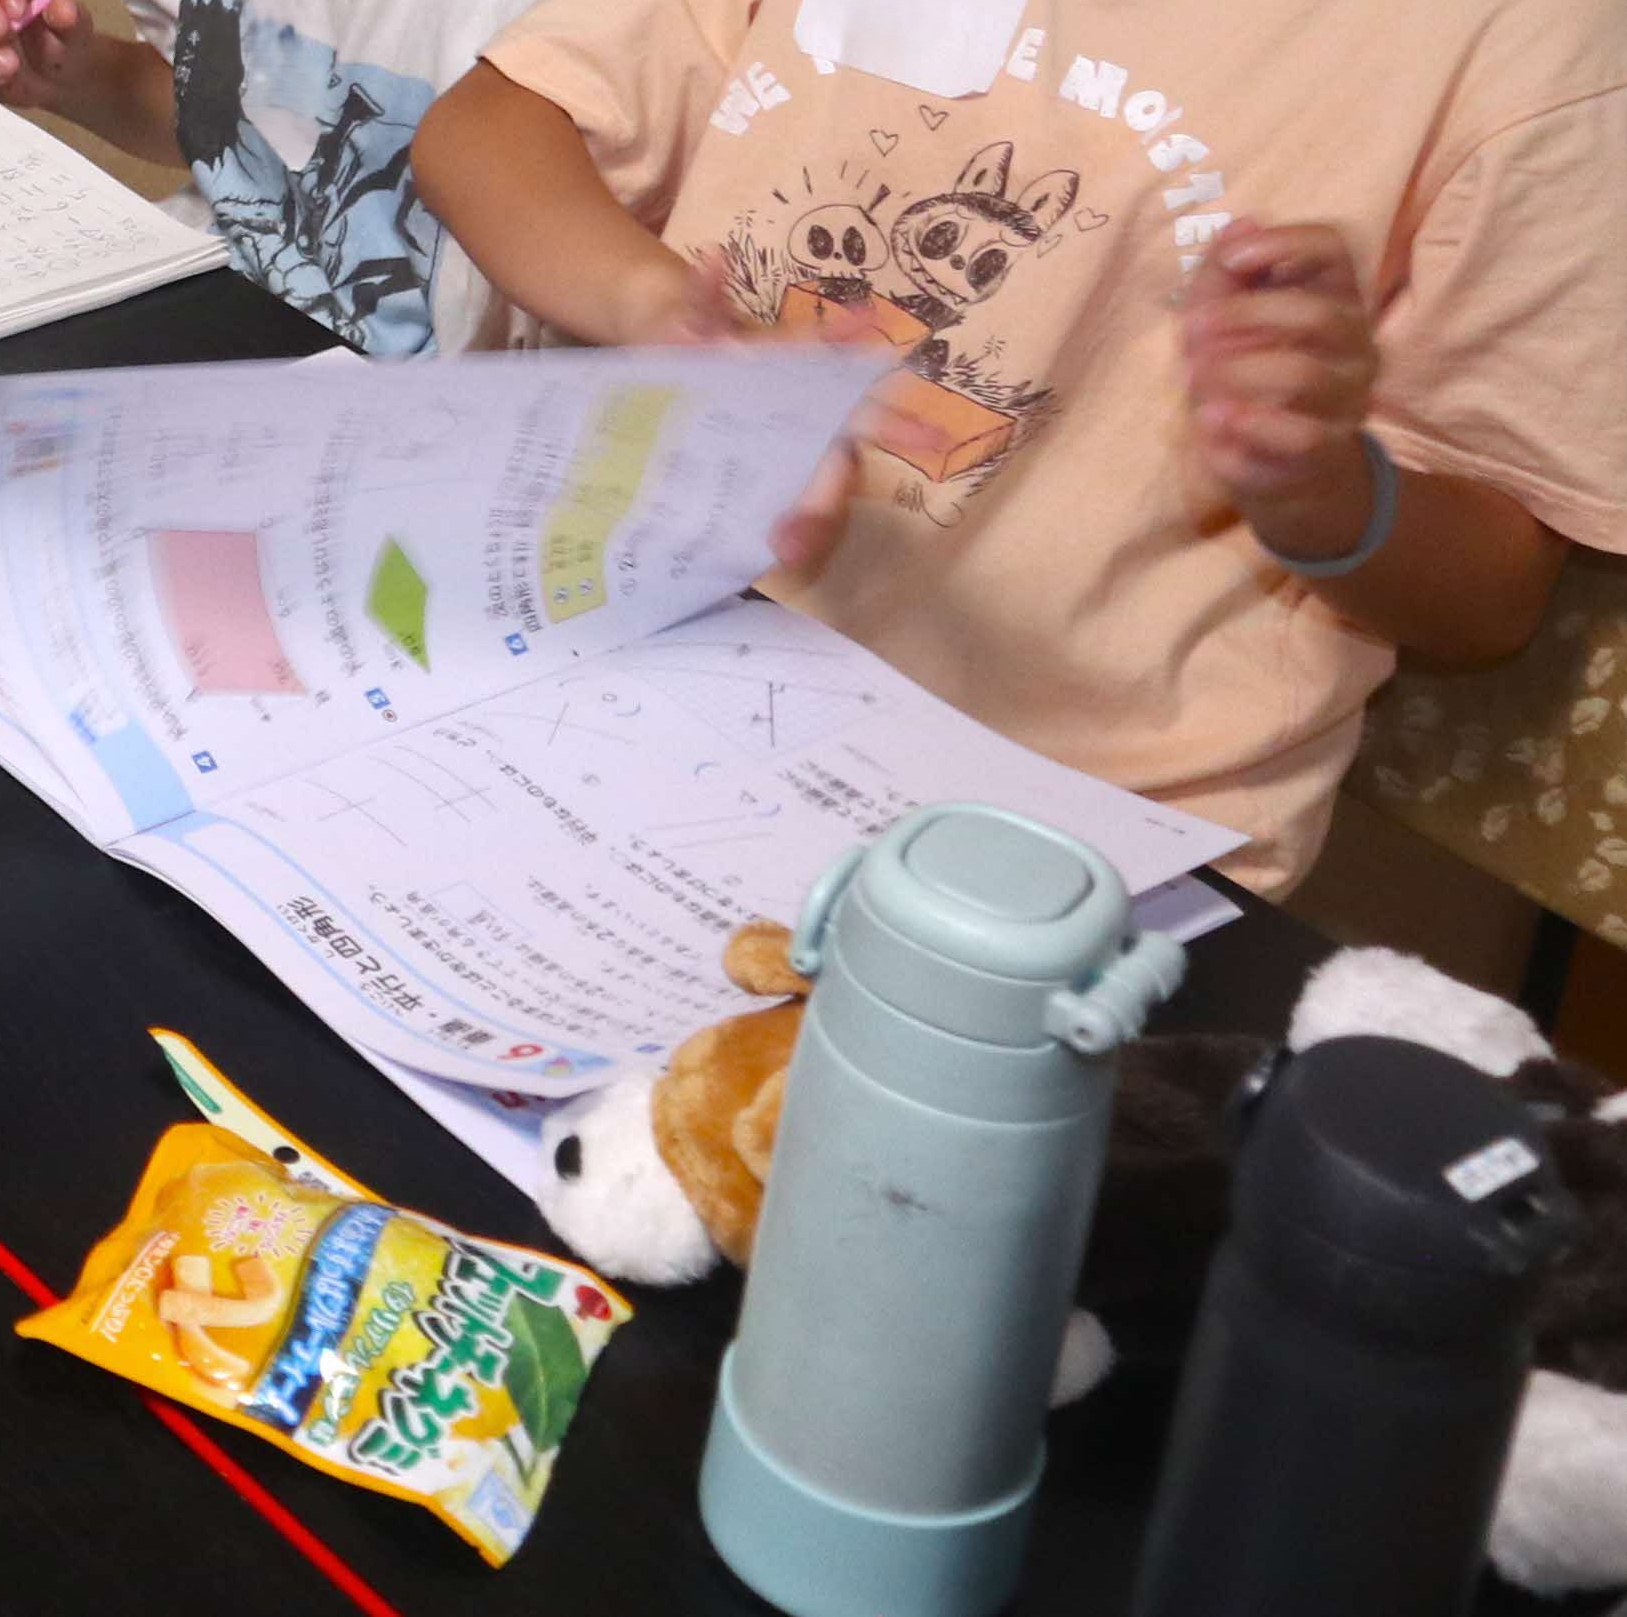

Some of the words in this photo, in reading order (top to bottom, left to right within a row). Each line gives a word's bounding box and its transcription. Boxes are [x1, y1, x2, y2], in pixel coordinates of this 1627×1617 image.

[343, 1245, 561, 1483] フェットチーネグミ
